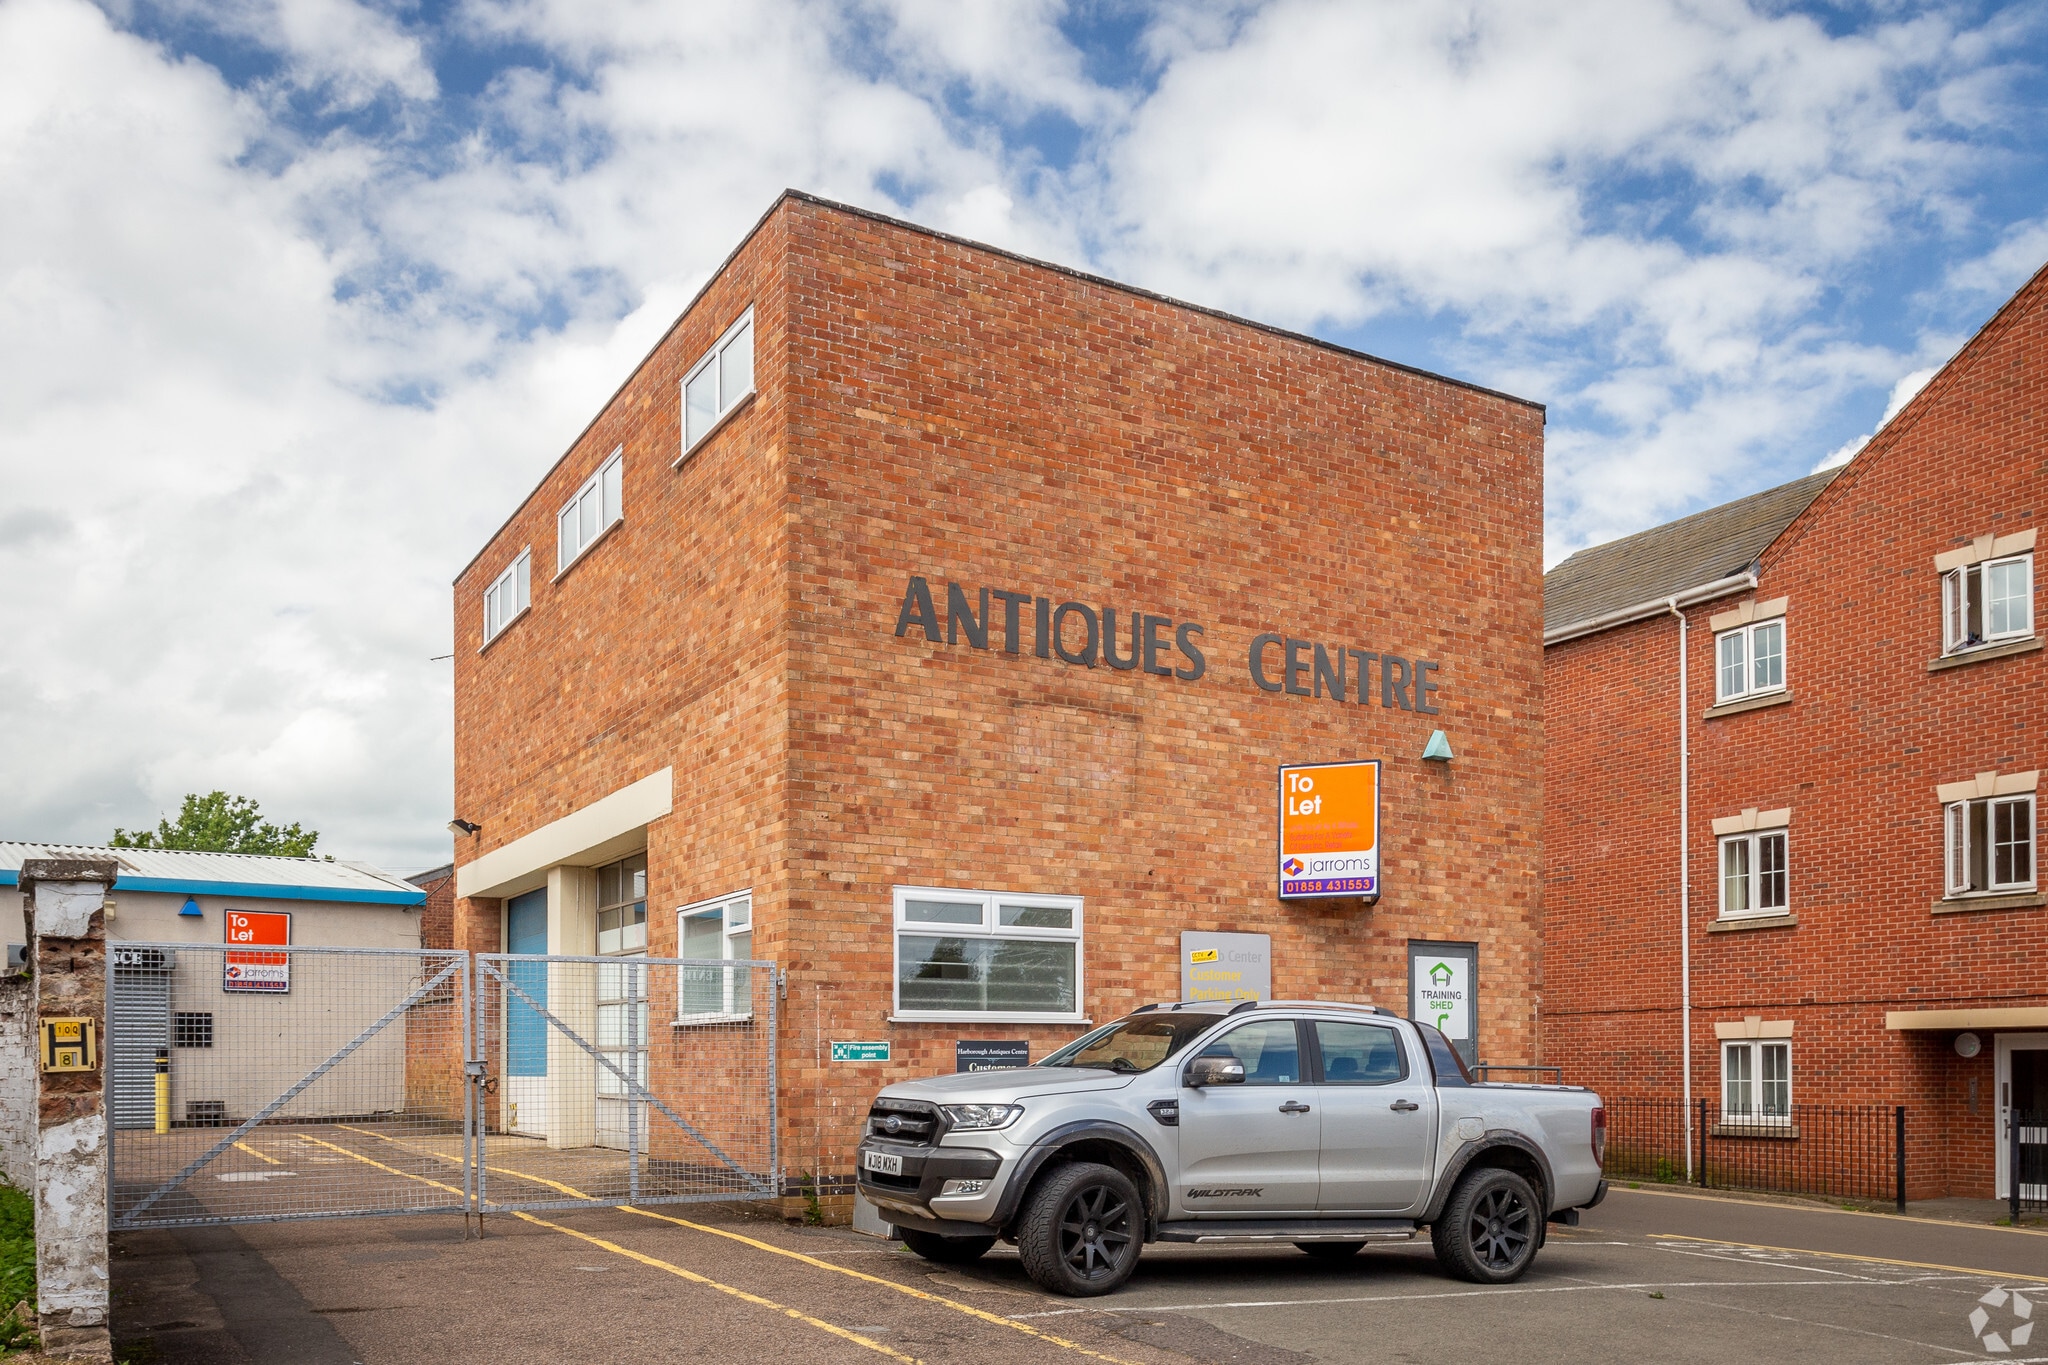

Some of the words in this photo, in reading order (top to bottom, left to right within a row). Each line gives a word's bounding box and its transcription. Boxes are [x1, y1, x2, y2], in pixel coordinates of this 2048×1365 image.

[895, 576, 1206, 680] ANTIQUES
[1248, 633, 1439, 714] CENTRE
[1288, 773, 1314, 793] To
[1289, 795, 1322, 816] Let
[1308, 858, 1370, 876] jarroms
[1286, 881, 1322, 893] 01858
[1326, 879, 1370, 891] 431553
[231, 914, 248, 927] To
[231, 928, 254, 941] Let
[1228, 950, 1262, 963] Center
[244, 967, 285, 979] jarroms
[1189, 967, 1242, 982] Customer
[1189, 987, 1232, 1003] Parking
[1235, 987, 1260, 1002] Only
[1421, 990, 1462, 999] TRAINING
[1430, 1000, 1453, 1010] SHED
[861, 1044, 888, 1052] assembly
[63, 1054, 71, 1065] 8
[882, 1155, 898, 1172] MXH
[1187, 1188, 1264, 1199] WILDTRAK
